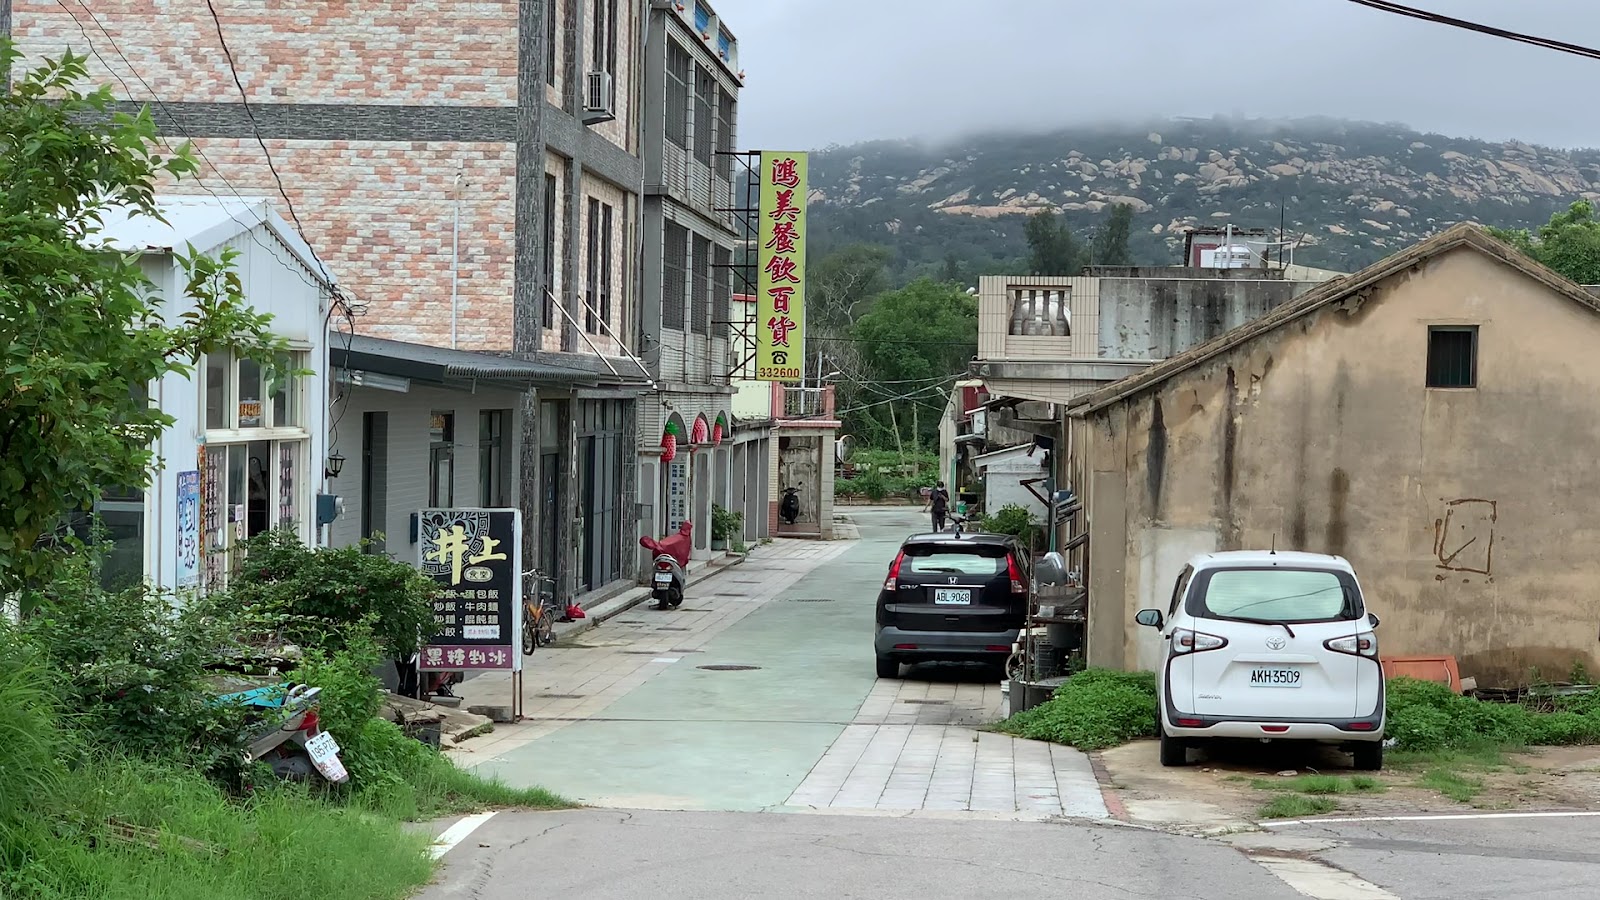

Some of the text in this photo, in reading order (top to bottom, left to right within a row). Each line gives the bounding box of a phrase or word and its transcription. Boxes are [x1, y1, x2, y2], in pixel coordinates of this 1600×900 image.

[765, 158, 800, 347] 鴻美餐飲百貨
[759, 367, 800, 378] 332600
[426, 524, 507, 586] 井上
[936, 590, 970, 602] ABL-9068
[1250, 669, 1301, 684] AKH-3509
